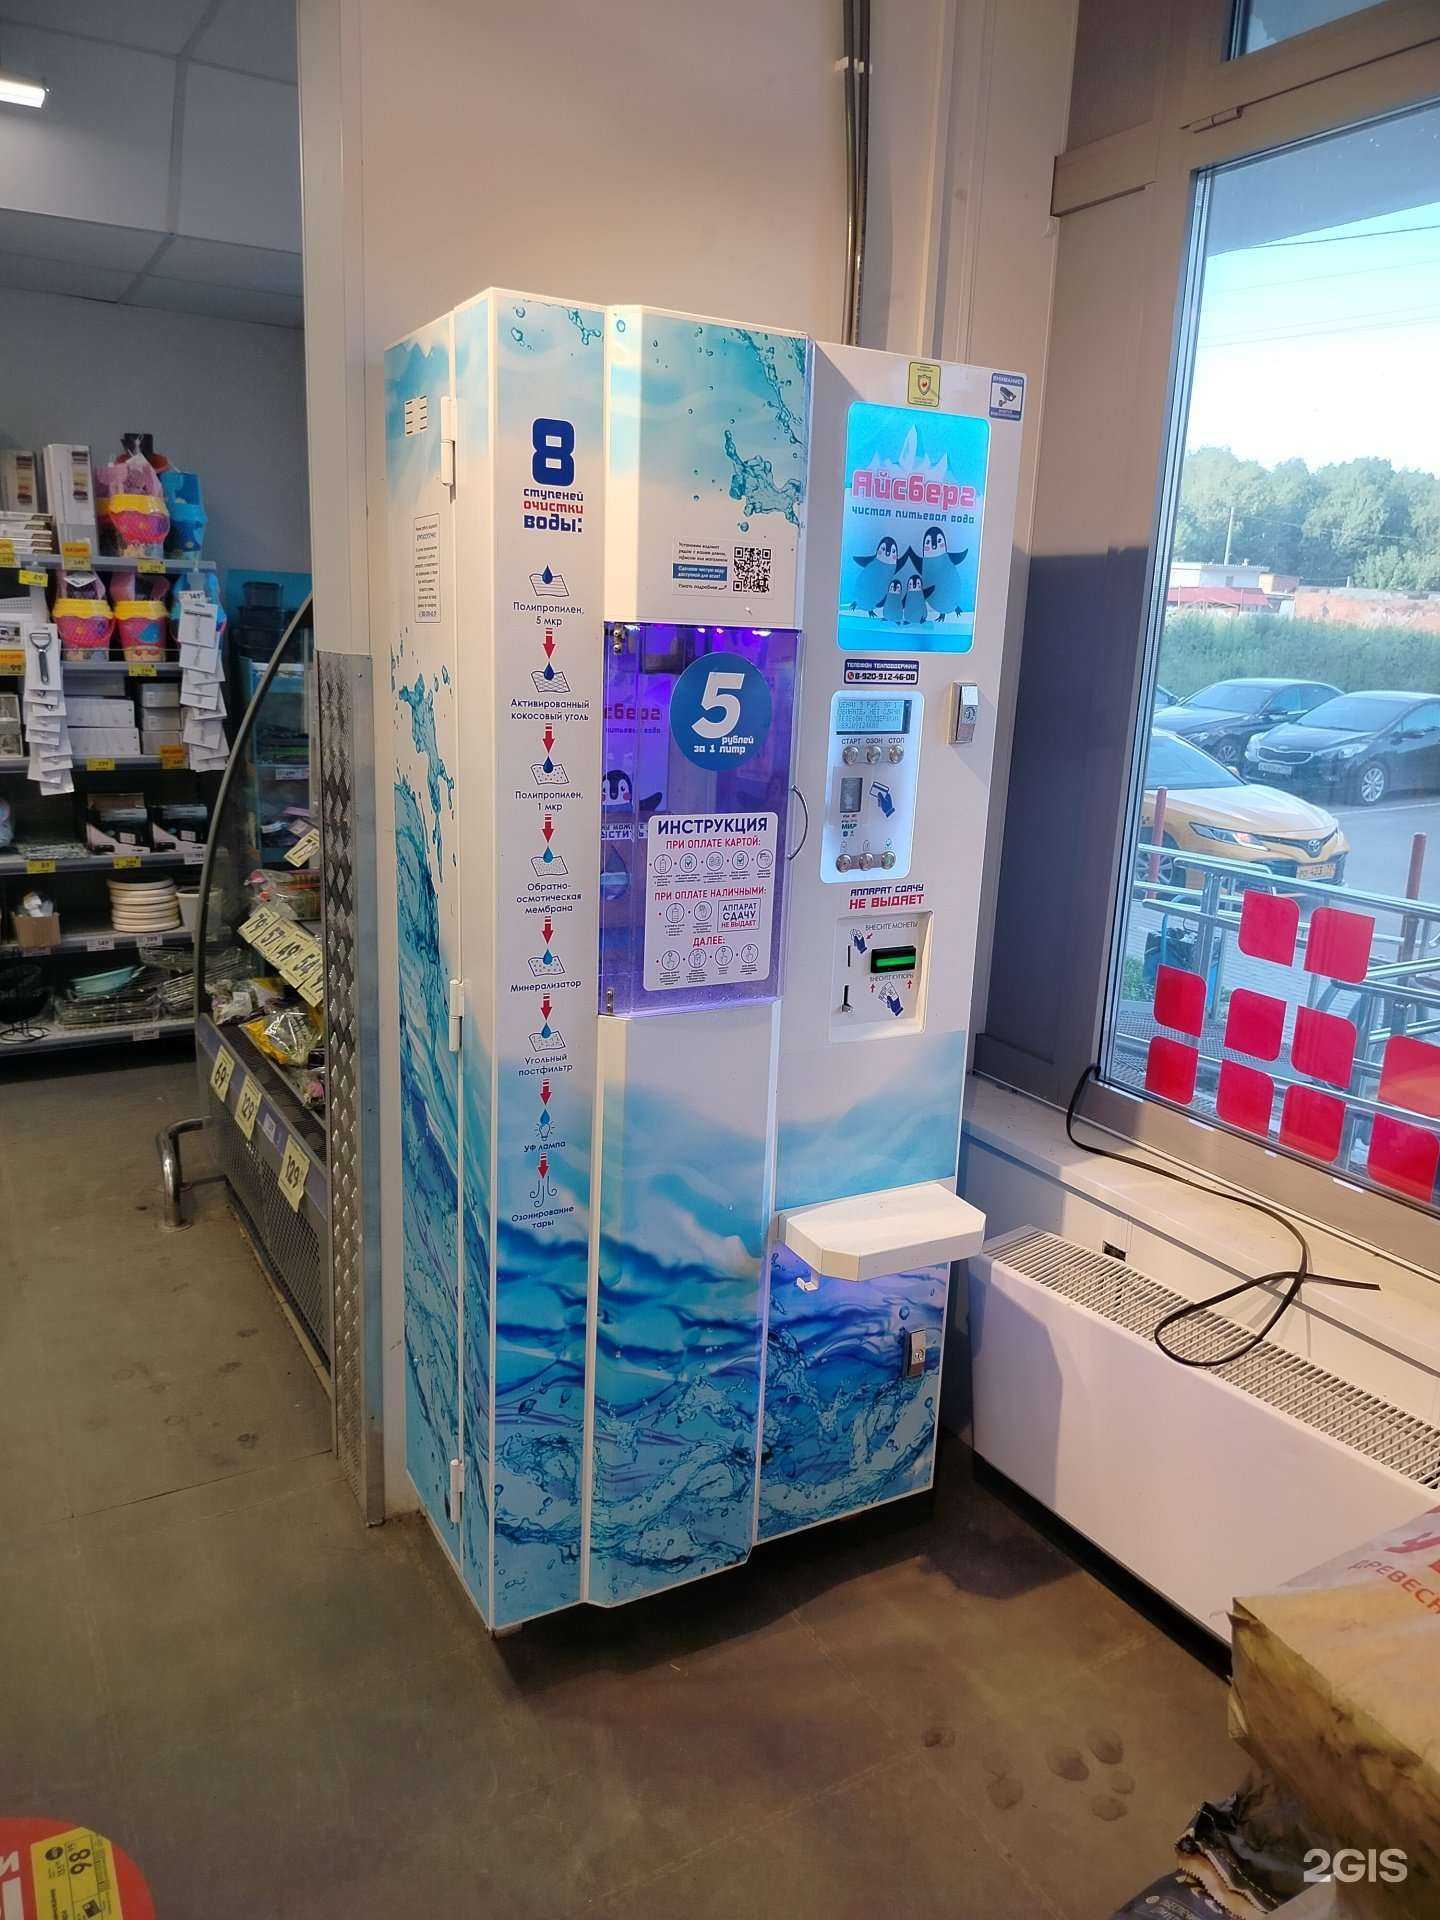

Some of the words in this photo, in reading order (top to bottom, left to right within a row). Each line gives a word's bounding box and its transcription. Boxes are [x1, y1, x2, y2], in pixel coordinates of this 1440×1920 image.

[532, 417, 575, 487] 8
[524, 488, 584, 502] ступеней
[852, 471, 976, 511] Айсберг
[524, 501, 584, 515] очистки
[852, 506, 892, 517] чистая
[895, 509, 947, 522] питьевая
[951, 514, 975, 524] вода
[524, 514, 583, 533] воды:
[536, 616, 542, 625] 5
[544, 617, 563, 628] мкр
[511, 699, 590, 709] Активированный
[691, 671, 745, 739] 5
[511, 711, 563, 721] кокосовый
[565, 714, 589, 722] уголь
[722, 736, 754, 745] рублей
[694, 745, 705, 753] за
[709, 745, 715, 753] 1
[719, 745, 746, 755] литр
[544, 804, 563, 813] мкр
[657, 817, 768, 835] ИНСТРУКЦИЯ
[666, 840, 685, 849] ПРИ
[688, 838, 723, 849] ОПЛАТЕ
[725, 835, 761, 847] КАРТОЙ:
[527, 883, 571, 893] Обратно-
[655, 892, 672, 901] ПРИ
[675, 889, 708, 900] ОПЛАТЕ
[711, 885, 767, 898] НАЛИЧНЫМИ:
[850, 886, 892, 897] АППАРАТ
[895, 884, 924, 893] СДАЧУ
[516, 894, 582, 904] осмотическая
[849, 899, 866, 910] НЕ
[870, 894, 925, 908] ВЫДАЕТ
[525, 904, 573, 914] мембрана
[723, 902, 758, 912] АППАРАТ
[723, 911, 757, 921] СДАЧУ
[721, 920, 730, 928] НЕ
[692, 936, 726, 948] ДАЛЕЕ:
[511, 980, 582, 993] Минерализатор
[525, 1053, 568, 1065] Угольный
[518, 1063, 573, 1077] постфильтр
[538, 1140, 566, 1151] лампа
[511, 1205, 575, 1222] Озонирование
[532, 1219, 554, 1230] тары
